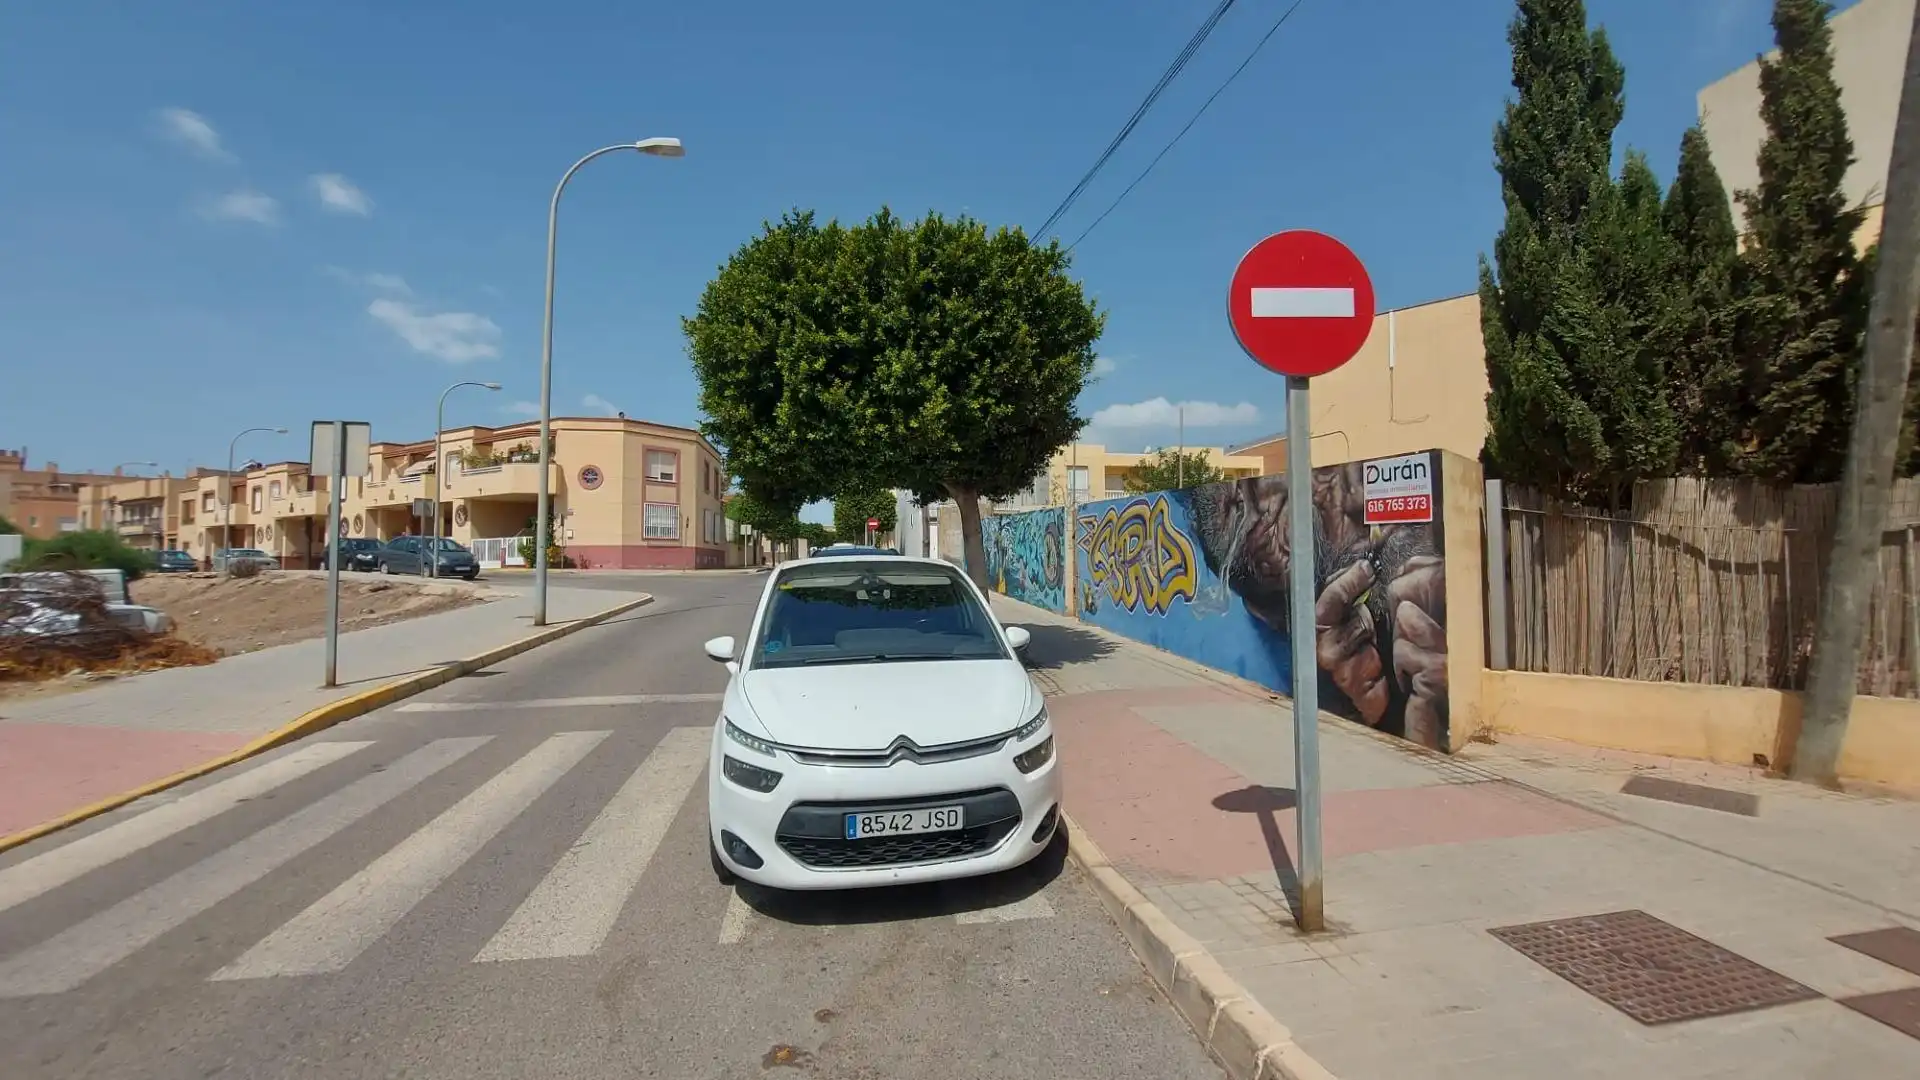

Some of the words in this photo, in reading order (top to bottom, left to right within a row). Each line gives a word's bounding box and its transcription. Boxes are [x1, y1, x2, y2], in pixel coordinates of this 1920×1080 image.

[1367, 460, 1426, 484] Durán
[1367, 500, 1384, 512] 616
[1386, 498, 1404, 511] 765
[1406, 497, 1427, 510] 373
[861, 813, 913, 834] 8542
[921, 809, 958, 829] JSD
